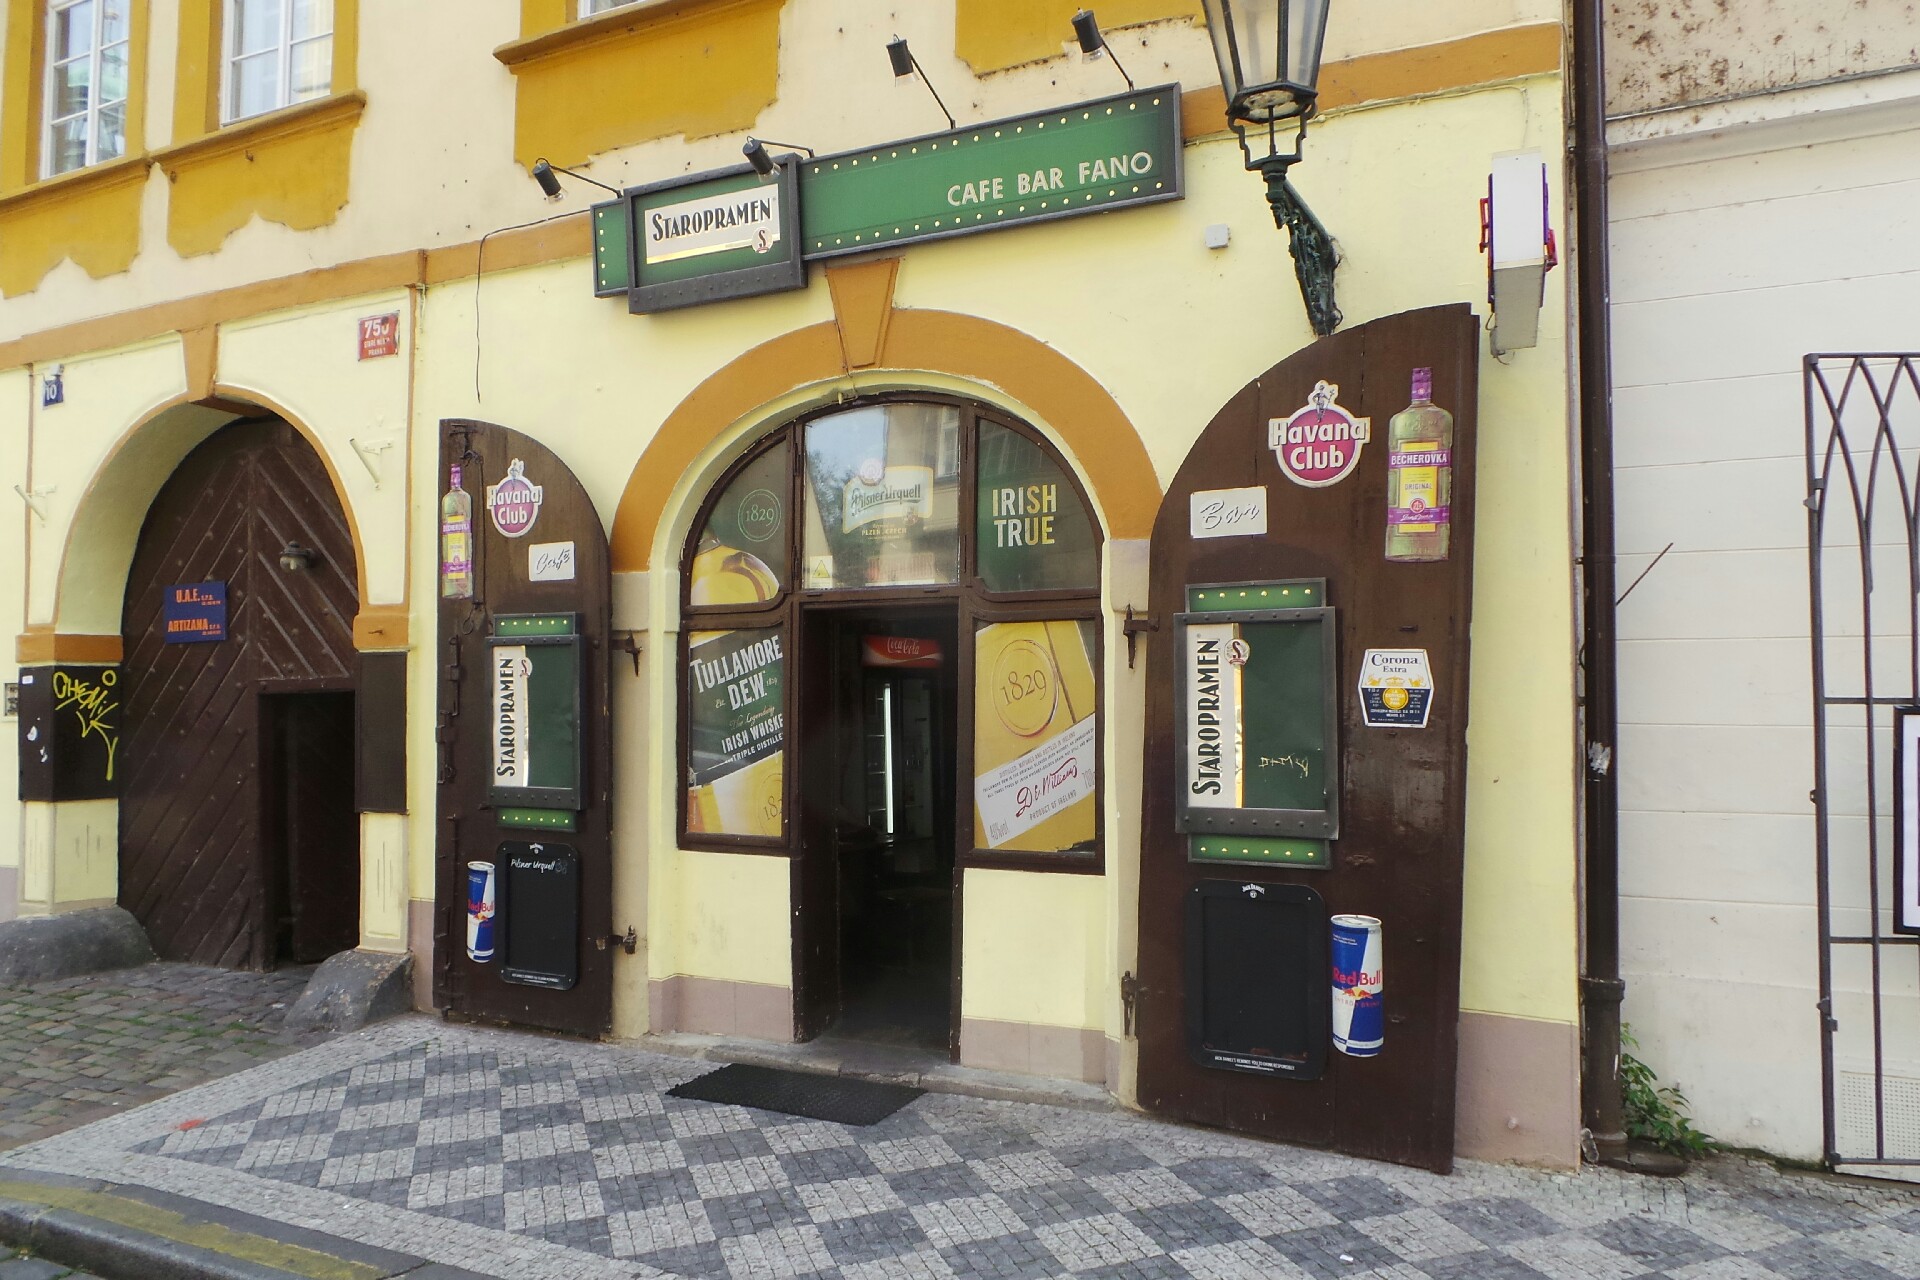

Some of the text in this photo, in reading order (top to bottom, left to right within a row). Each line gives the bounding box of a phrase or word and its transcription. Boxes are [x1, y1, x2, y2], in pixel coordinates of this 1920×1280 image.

[947, 151, 1153, 207] CAFE BAR FANO
[652, 197, 771, 242] STAROPRAMEN
[46, 384, 57, 401] 10
[1273, 421, 1367, 446] Havana
[1290, 444, 1345, 470] Club
[1391, 453, 1448, 466] BECHEROVKA
[489, 488, 542, 506] Havana
[851, 483, 921, 516] Pilsner Urquell
[992, 484, 1057, 517] IRISH
[497, 506, 528, 525] Club
[745, 504, 775, 527] 1829
[993, 516, 1055, 548] TRUE
[176, 588, 200, 603] U.A.E.
[689, 634, 783, 693] TULLAMORE
[1371, 653, 1418, 667] Corona
[1383, 665, 1407, 673] Extra
[727, 671, 767, 710] D.E.W.
[1000, 668, 1047, 706] 1829
[496, 658, 516, 777] STAROPRAMEN
[1192, 640, 1222, 796] STAROPRAMEN
[721, 729, 749, 754] IRISH
[756, 732, 784, 751] DISTILLE
[510, 857, 532, 869] Pilsner
[532, 860, 556, 873] Urquell
[481, 902, 494, 912] Bull
[1332, 966, 1383, 986] Red Bull
